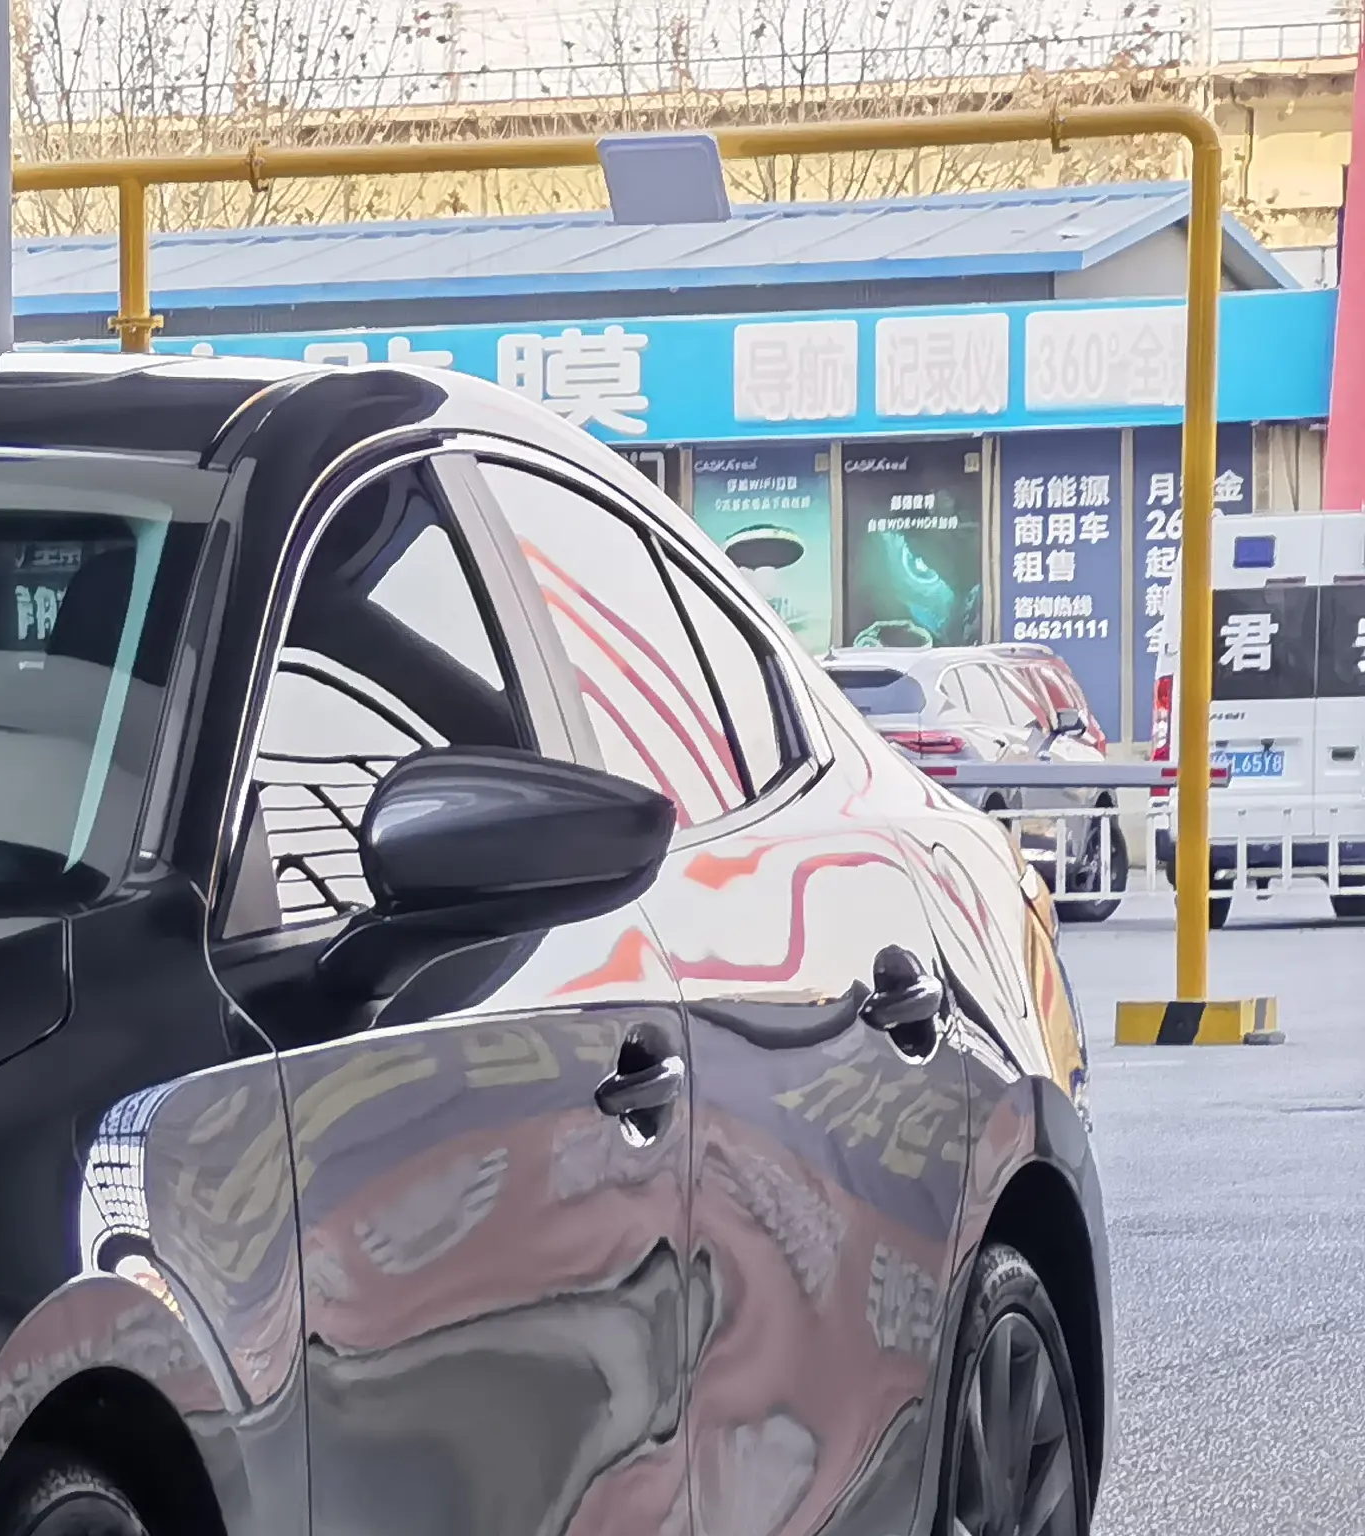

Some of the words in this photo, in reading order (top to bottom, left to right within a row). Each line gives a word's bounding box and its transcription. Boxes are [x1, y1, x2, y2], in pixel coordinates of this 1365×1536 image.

[746, 337, 847, 412] 导航
[887, 329, 999, 412] 记录仪
[1039, 323, 1186, 400] 360°全
[1012, 474, 1110, 509] 新能源
[1146, 469, 1244, 506] 月金
[1013, 511, 1110, 547] 商用车
[1012, 549, 1077, 583] 租售
